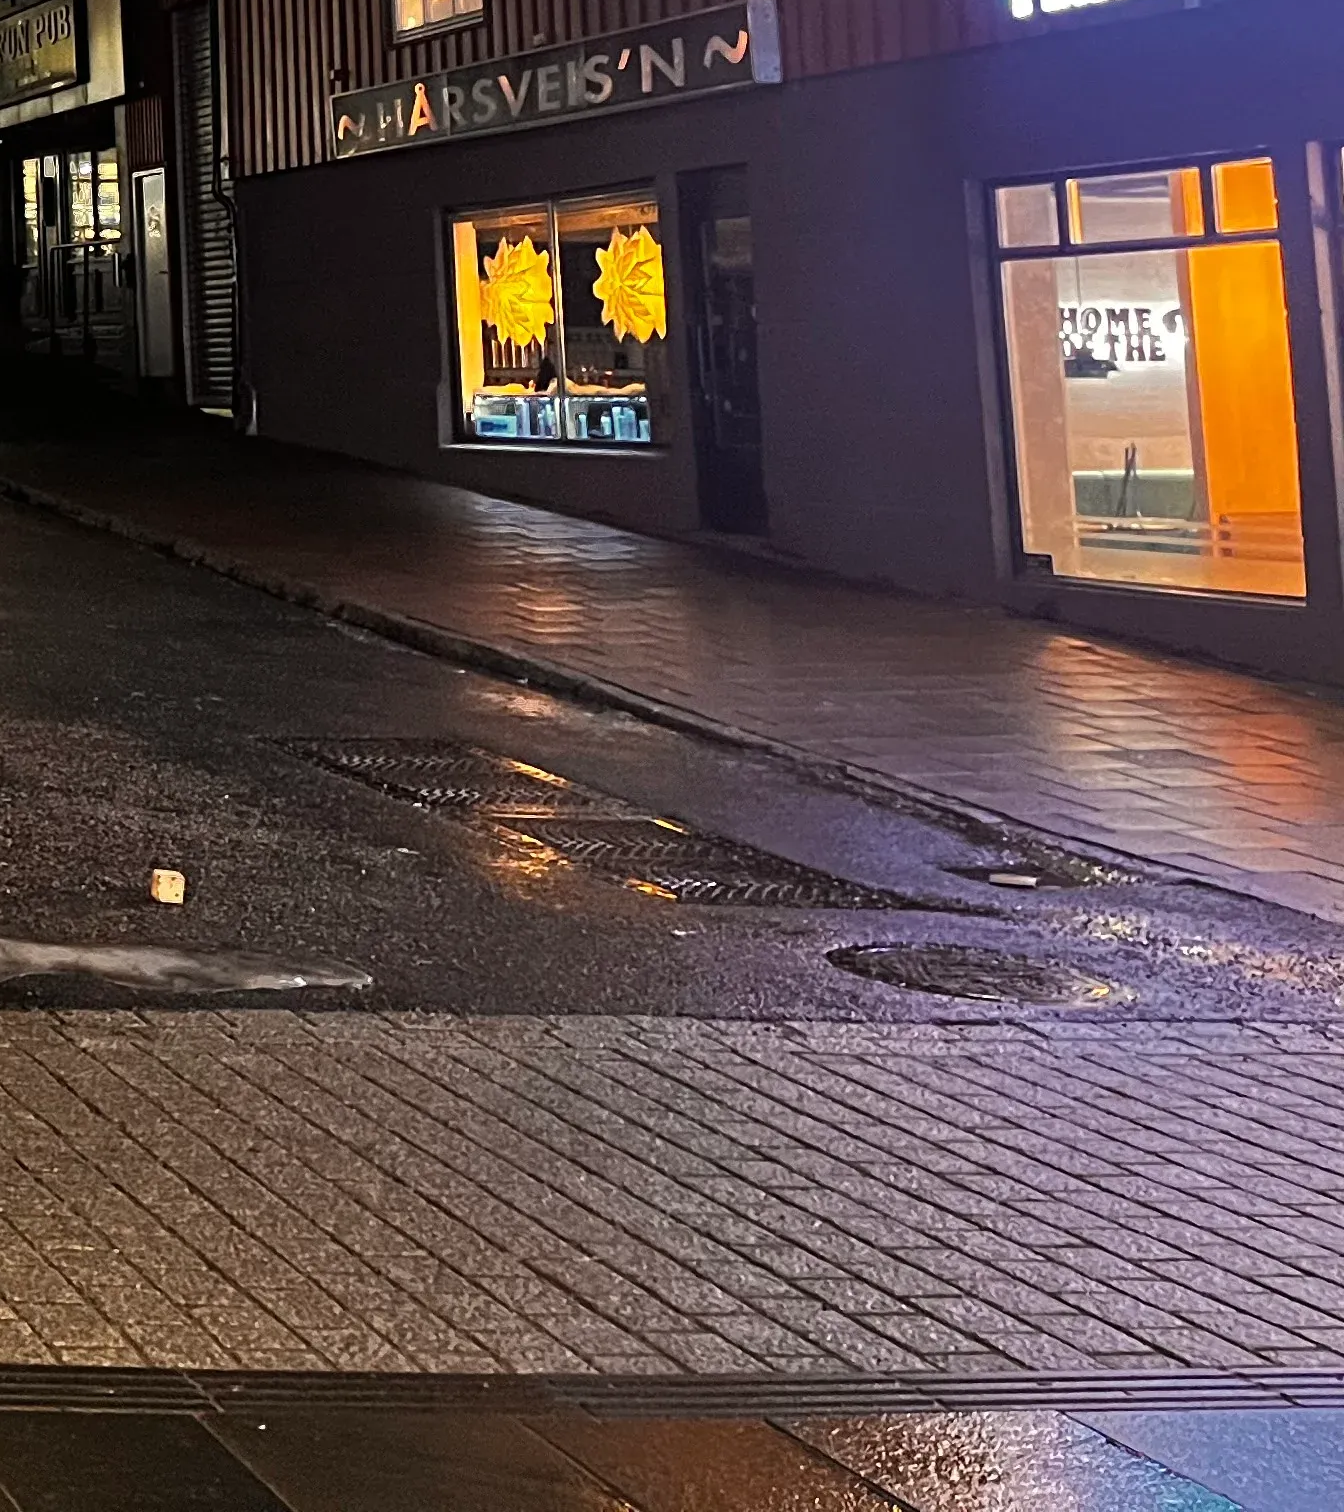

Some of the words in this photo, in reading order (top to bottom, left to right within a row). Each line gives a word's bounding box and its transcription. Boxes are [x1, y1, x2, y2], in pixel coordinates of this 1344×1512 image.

[35, 4, 72, 49] PUB
[1058, 307, 1152, 336] HOME
[1104, 334, 1166, 362] THE
